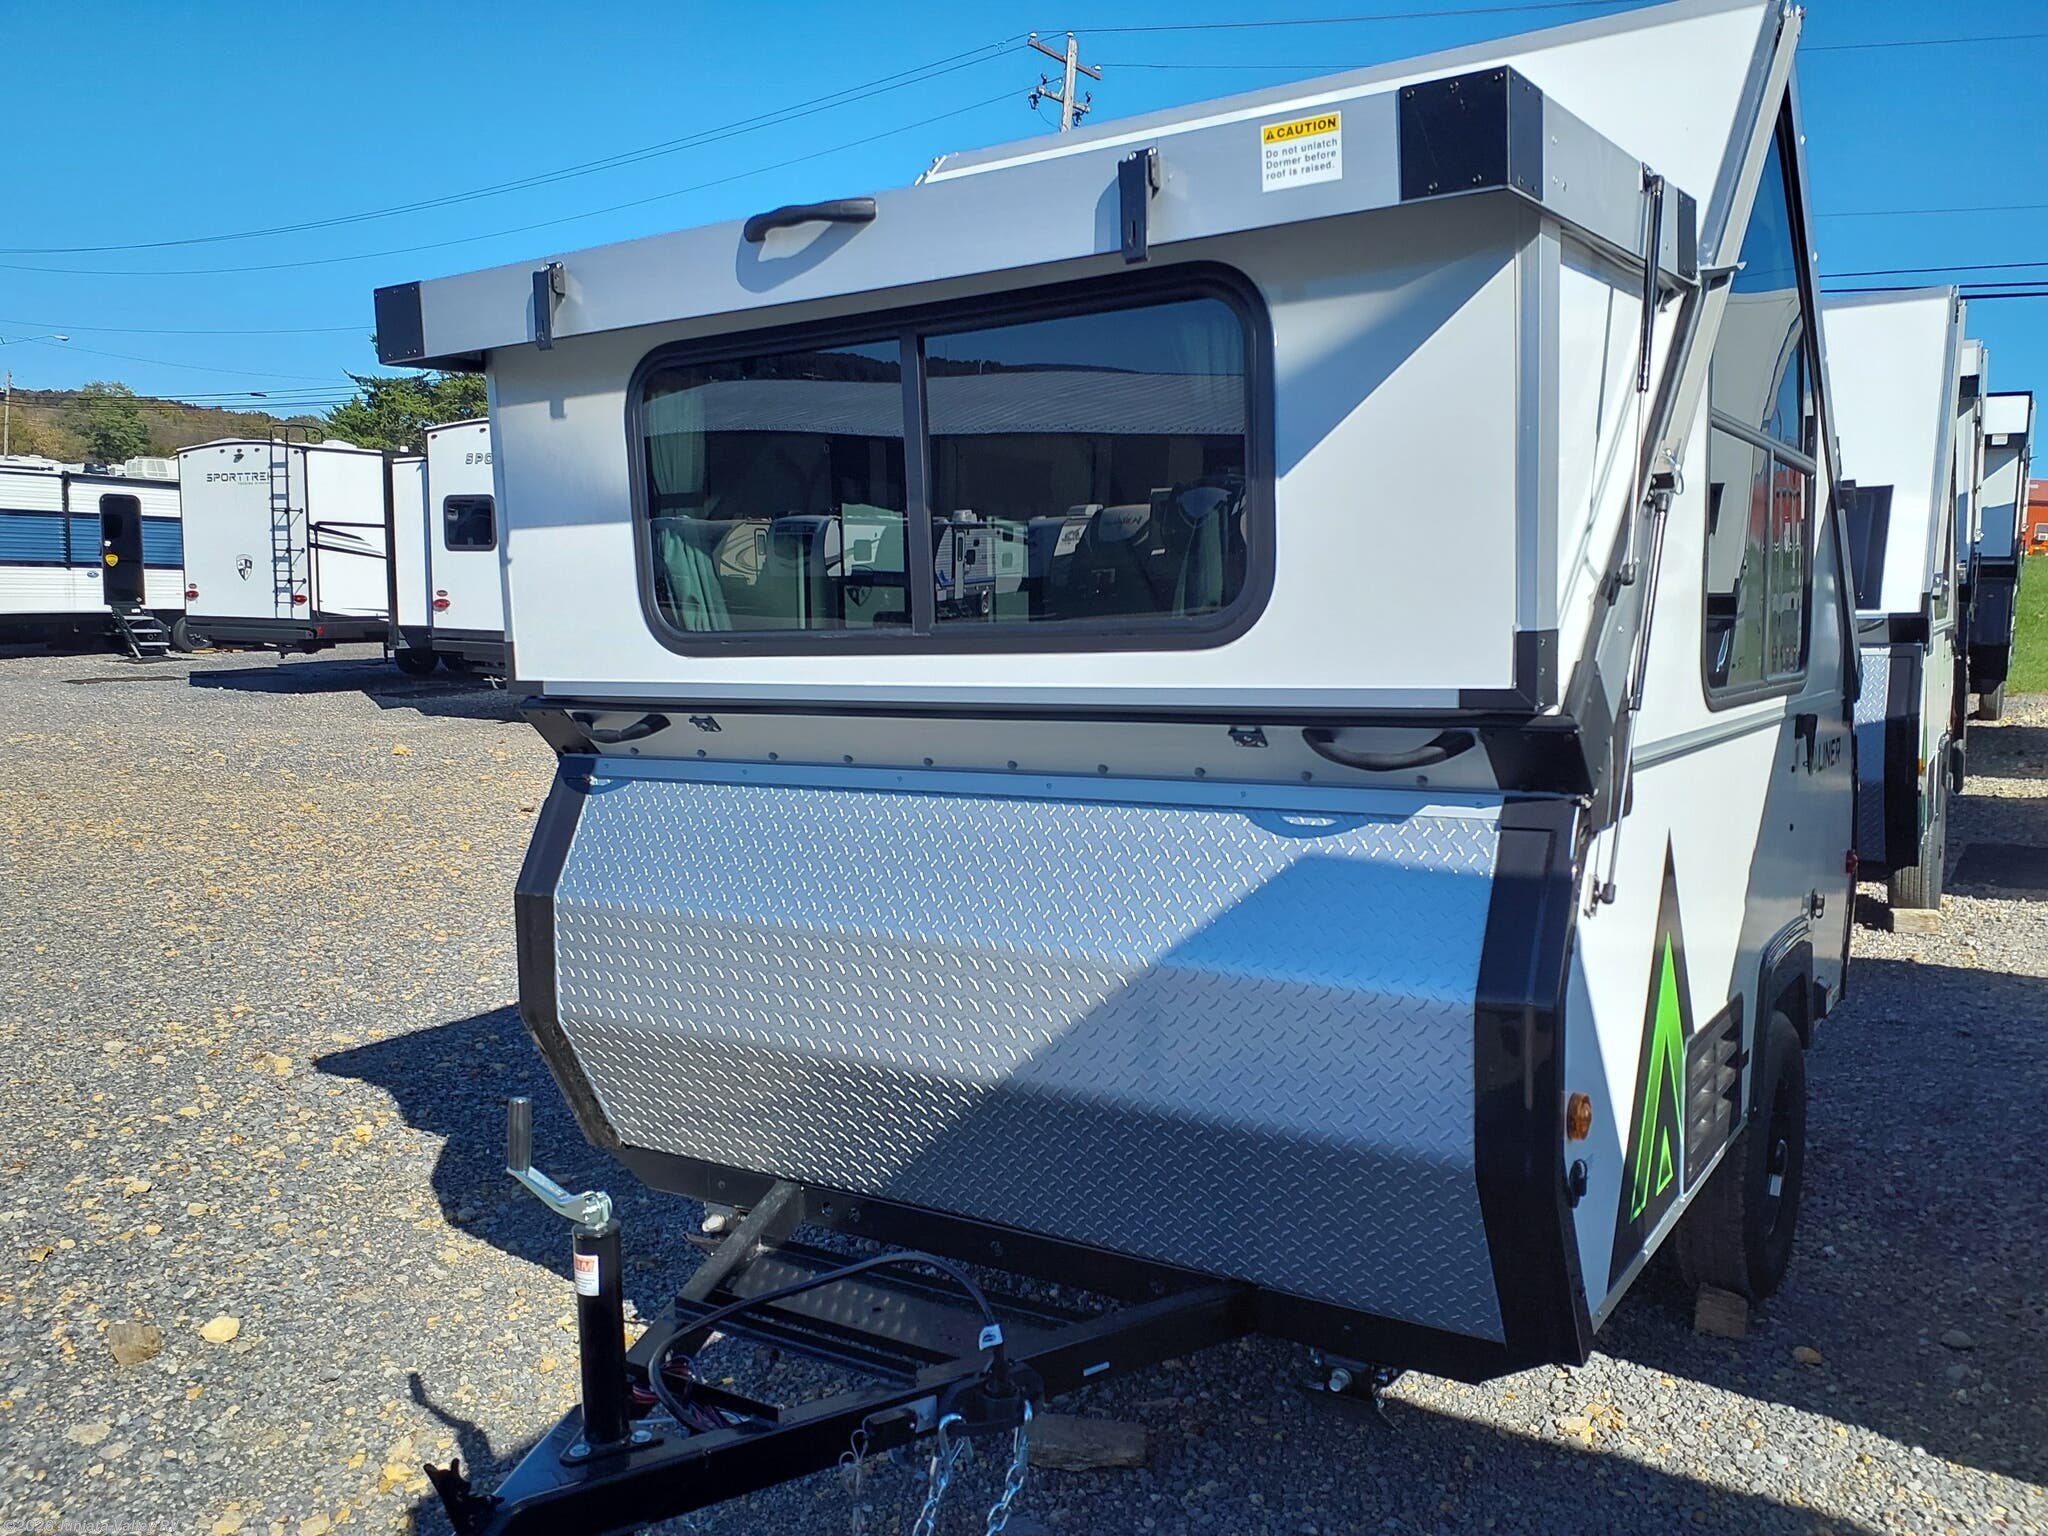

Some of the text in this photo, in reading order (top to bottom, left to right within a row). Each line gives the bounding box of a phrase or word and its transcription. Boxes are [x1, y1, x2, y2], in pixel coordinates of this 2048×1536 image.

[1277, 118, 1336, 137] CAUTION
[1266, 138, 1337, 159] Do not unlatch
[1266, 150, 1336, 169] Dormer before
[1266, 161, 1335, 180] roof is raised.
